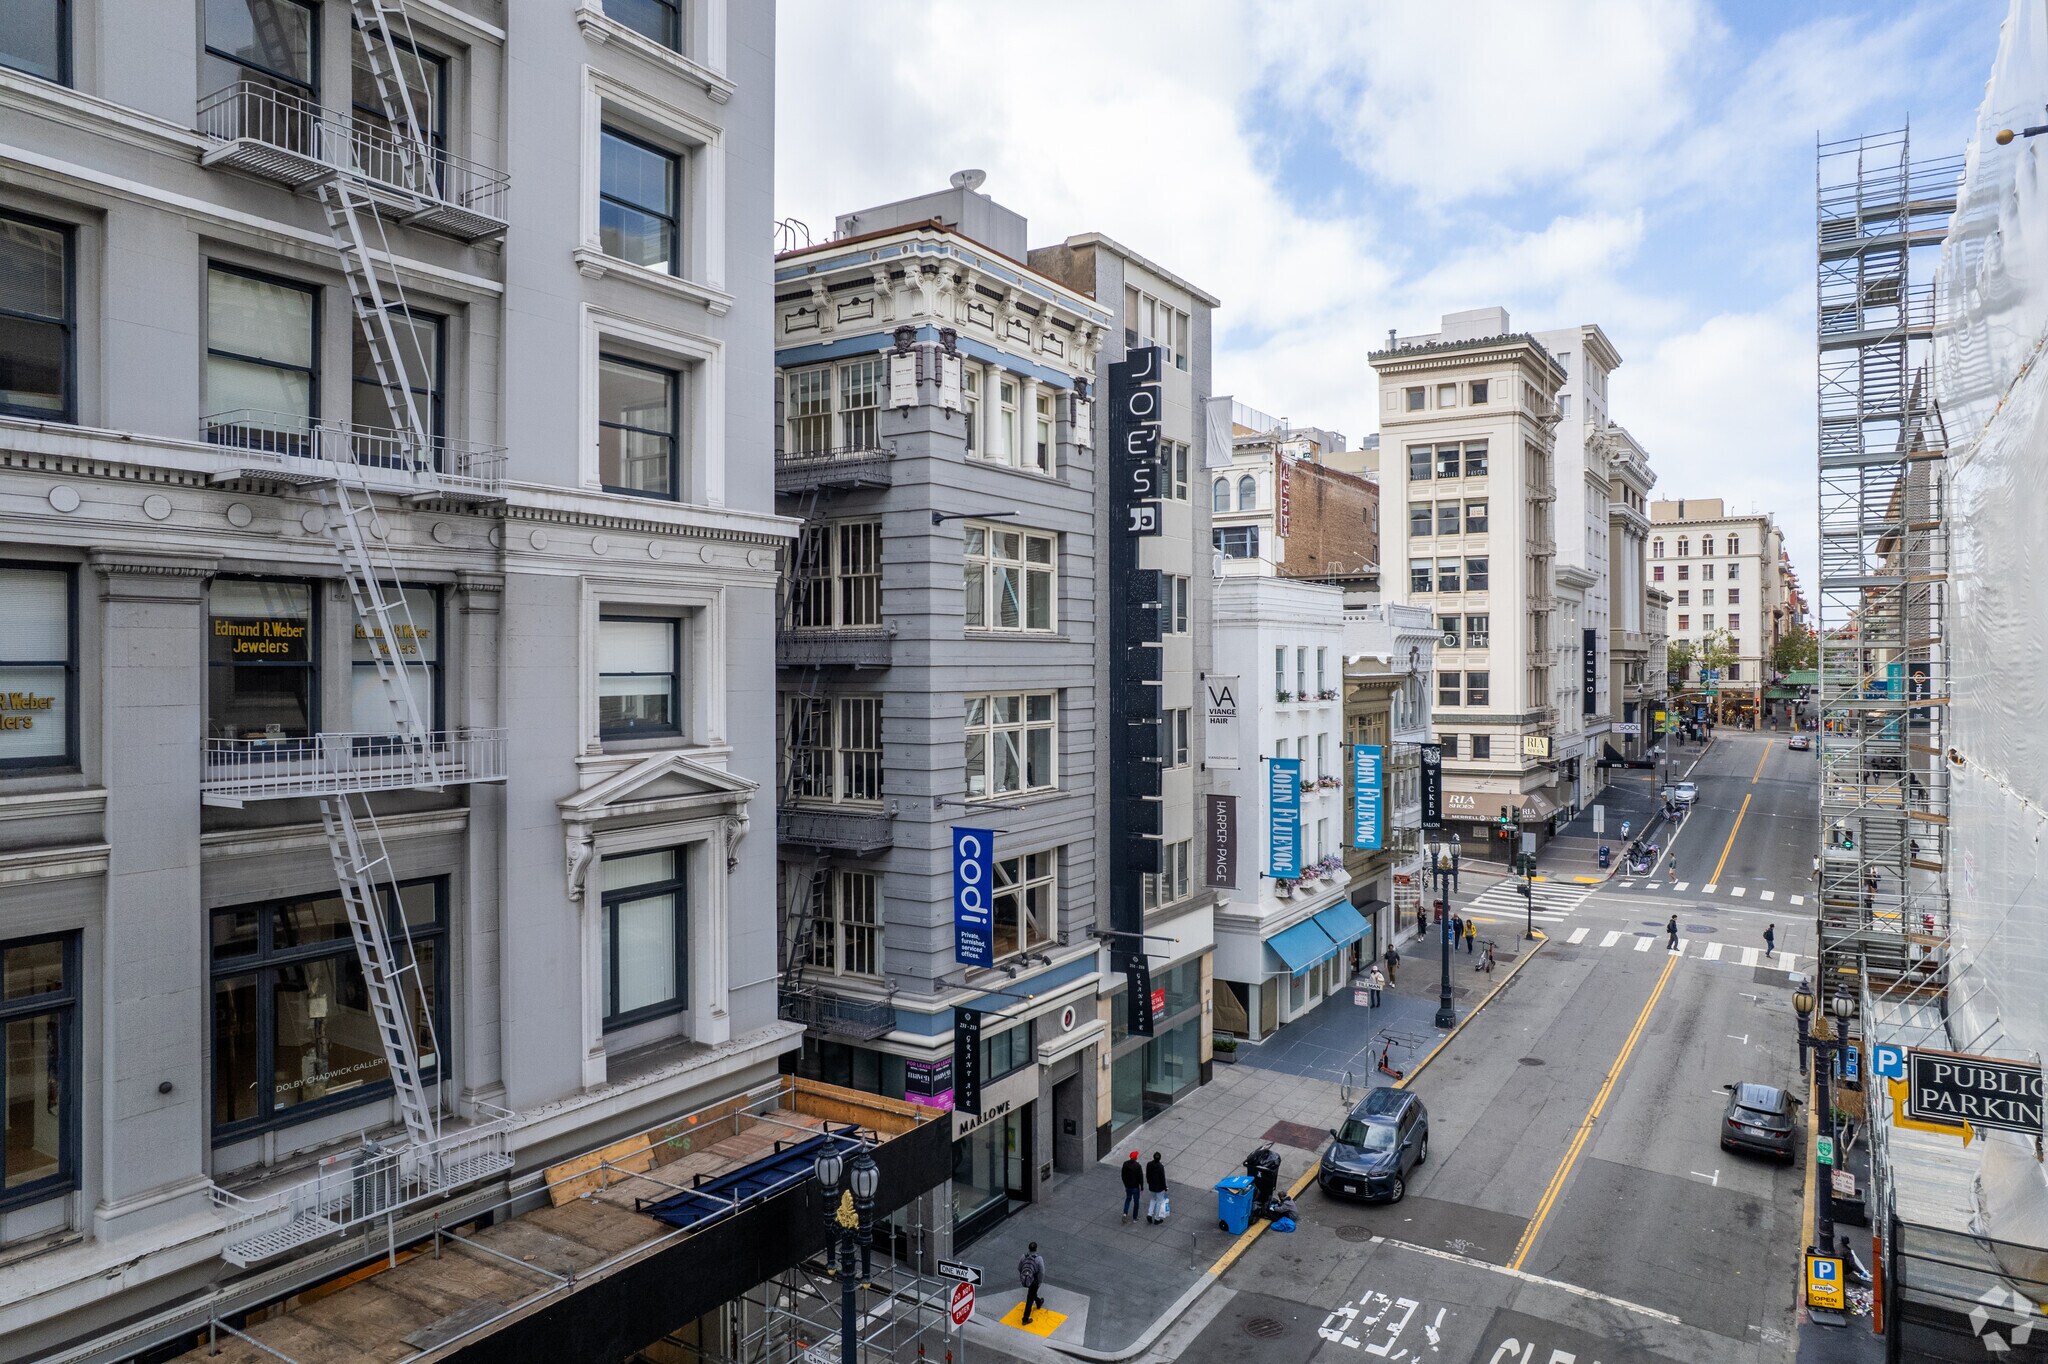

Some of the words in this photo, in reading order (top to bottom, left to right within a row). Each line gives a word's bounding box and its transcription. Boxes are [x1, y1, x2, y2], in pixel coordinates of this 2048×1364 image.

[214, 620, 260, 636] Edmund
[233, 638, 289, 653] Jewelers
[1586, 650, 1594, 693] GEFEN
[1208, 685, 1236, 708] VA
[1208, 708, 1237, 716] VIANGE
[1209, 717, 1228, 725] HAIR
[1527, 737, 1545, 749] RIA
[1357, 750, 1380, 785] JOHN
[1272, 764, 1298, 804] JOHN
[1427, 769, 1436, 816] WICKED
[1449, 795, 1476, 804] RIA
[1216, 800, 1227, 843] HARPER
[1357, 787, 1380, 843] FLUEVOG
[1272, 807, 1298, 872] FLUEVOG
[1216, 848, 1227, 882] PAIGE
[959, 835, 988, 925] codi
[961, 931, 980, 940] Private,
[961, 938, 986, 949] furnished,
[961, 945, 983, 954] serviced
[961, 951, 980, 960] offices.
[275, 1078, 305, 1093] DOLBY
[306, 1066, 352, 1084] CHADWICK
[353, 1057, 388, 1072] GALLERY
[916, 1062, 931, 1070] LEASE
[1933, 1062, 2043, 1098] PUBLIC
[1921, 1087, 2043, 1126] PARKIN
[960, 1100, 1011, 1135] MARLOWE
[941, 1265, 955, 1274] ONE
[955, 1268, 969, 1277] WAY
[954, 1292, 961, 1303] DO
[962, 1284, 971, 1296] NOT
[1814, 1295, 1837, 1303] OPEN
[956, 1304, 970, 1320] ENTER
